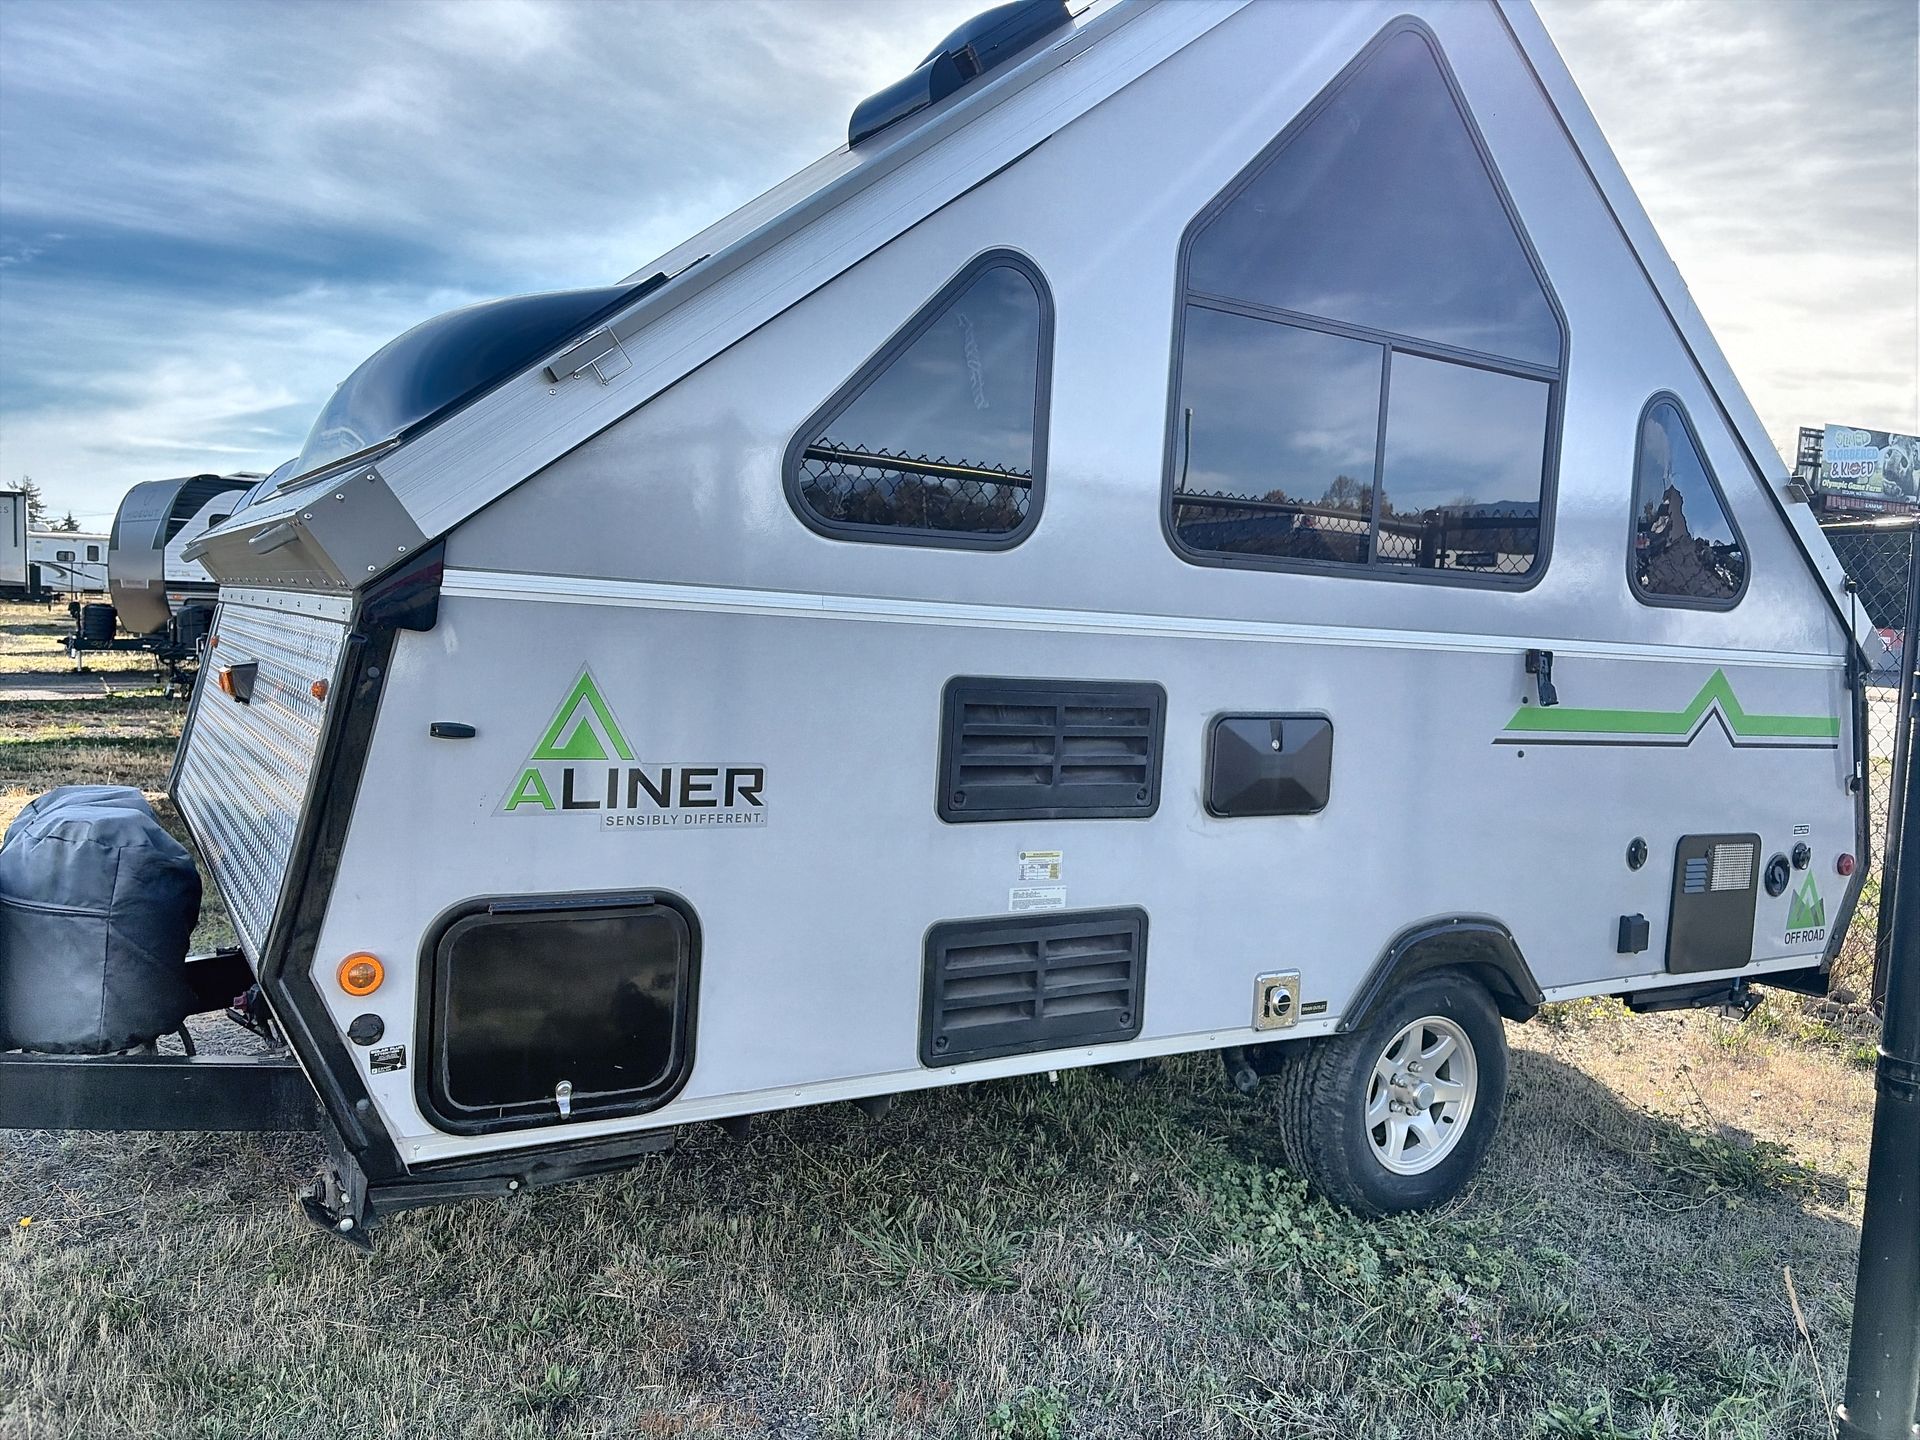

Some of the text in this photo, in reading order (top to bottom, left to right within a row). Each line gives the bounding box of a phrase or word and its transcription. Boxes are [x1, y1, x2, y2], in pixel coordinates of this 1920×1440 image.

[1822, 479, 1882, 492] Olympic Game Farm
[503, 768, 765, 811] ALINER
[606, 812, 765, 826] SENSIBLY DIFFERENT.
[1784, 929, 1825, 945] OFF ROAD
